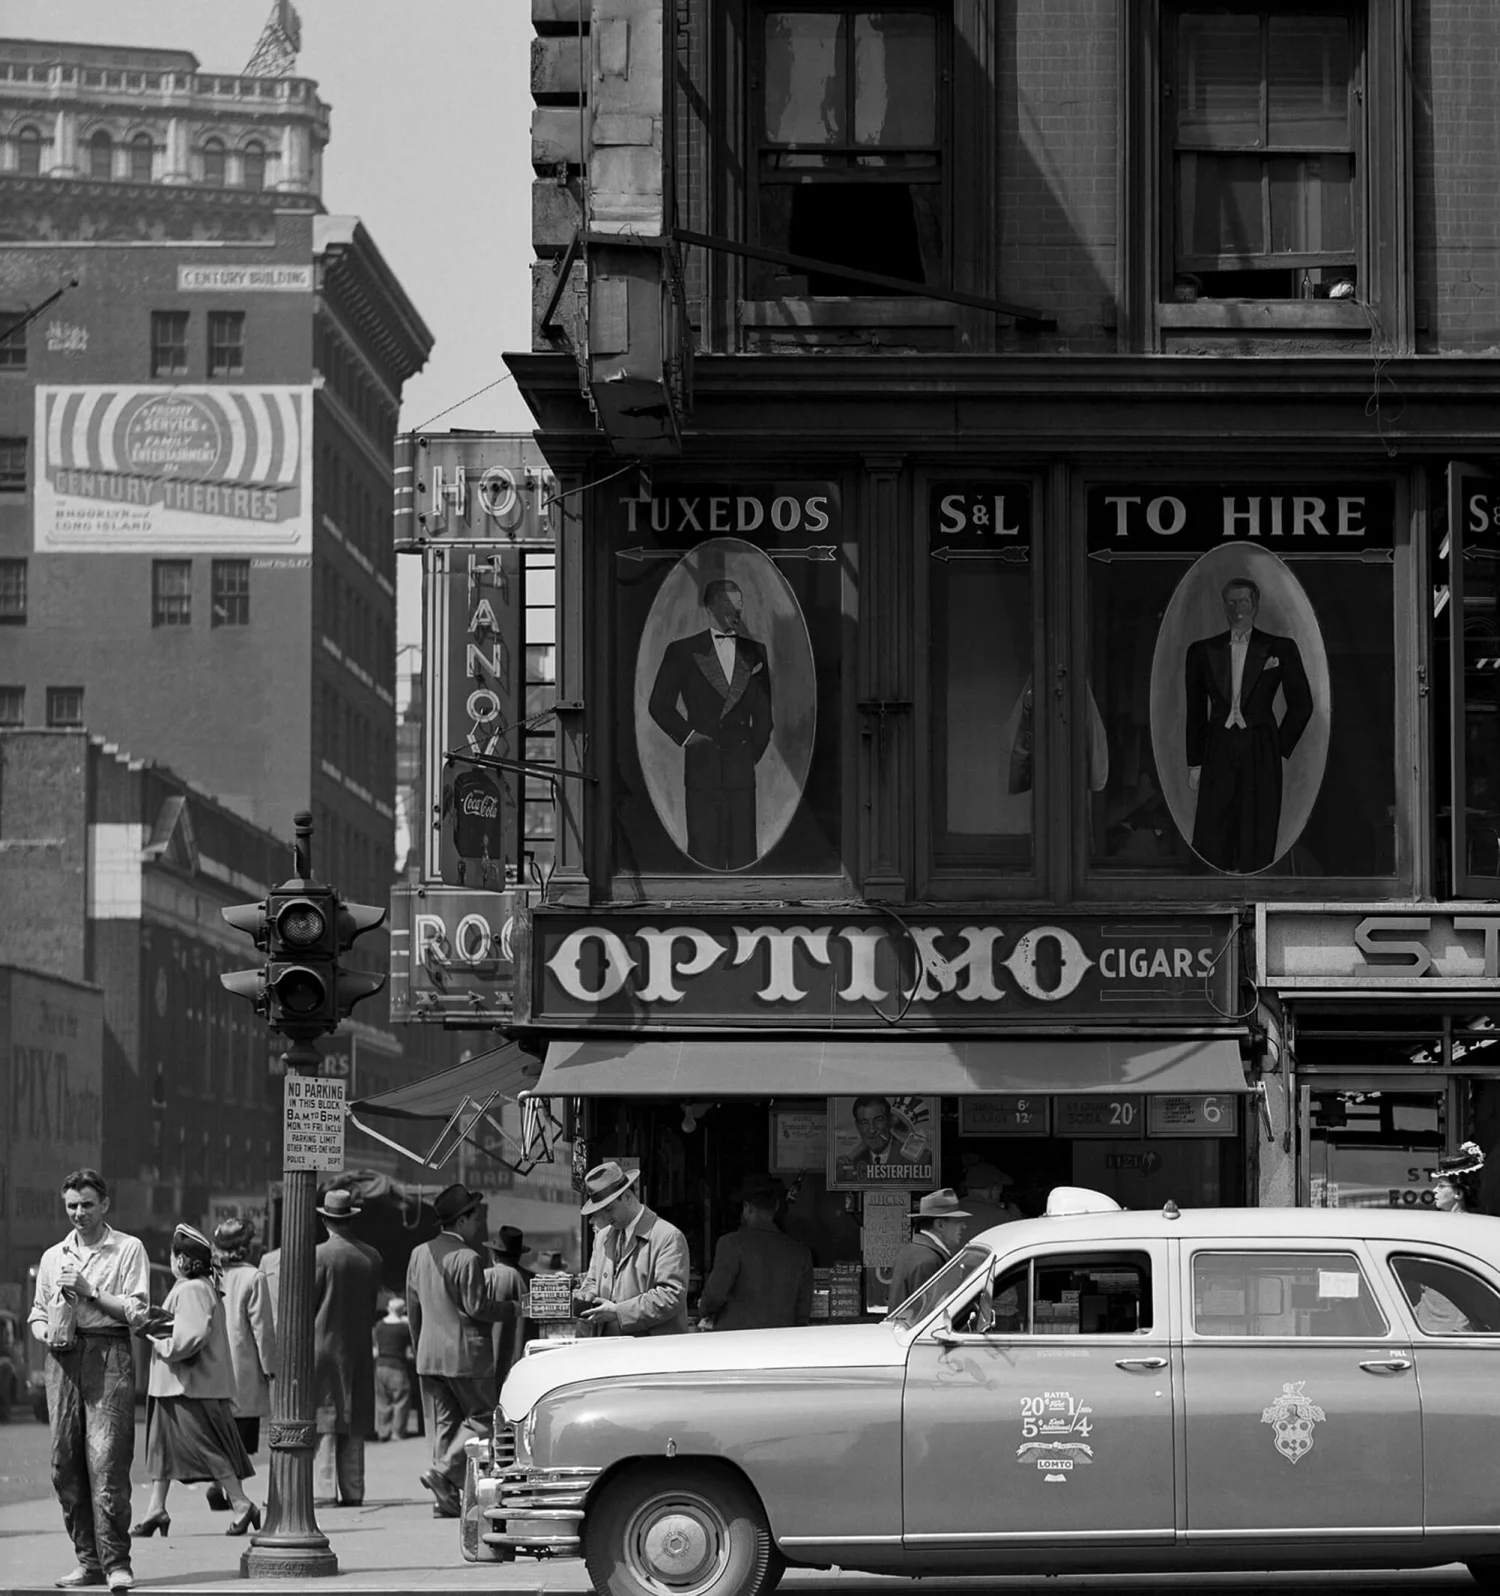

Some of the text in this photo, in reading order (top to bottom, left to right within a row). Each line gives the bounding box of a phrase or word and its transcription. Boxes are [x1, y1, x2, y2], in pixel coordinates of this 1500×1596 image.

[183, 270, 306, 286] CENTURY BUILDING
[144, 418, 200, 432] SERVICE
[144, 436, 193, 446] FAMILY
[55, 471, 279, 520] CENTURY THEATRES
[618, 497, 830, 532] TUXEDOS
[939, 494, 1019, 535] S&L
[1105, 495, 1366, 537] TO HIRE
[55, 521, 152, 532] LONG ISLAND
[544, 925, 1096, 1002] OPTIMO
[1100, 946, 1215, 979] CIGARS
[288, 1083, 343, 1100] NO PARKING
[290, 1099, 340, 1109] IN THIS BLOCK
[972, 1113, 1008, 1123] LARGE
[1068, 1113, 1102, 1124] SODA
[292, 1134, 336, 1144] PARKING LIMIT
[287, 1144, 302, 1152] OTHER
[287, 1155, 305, 1164] POLICE
[1389, 1188, 1440, 1204] FOO
